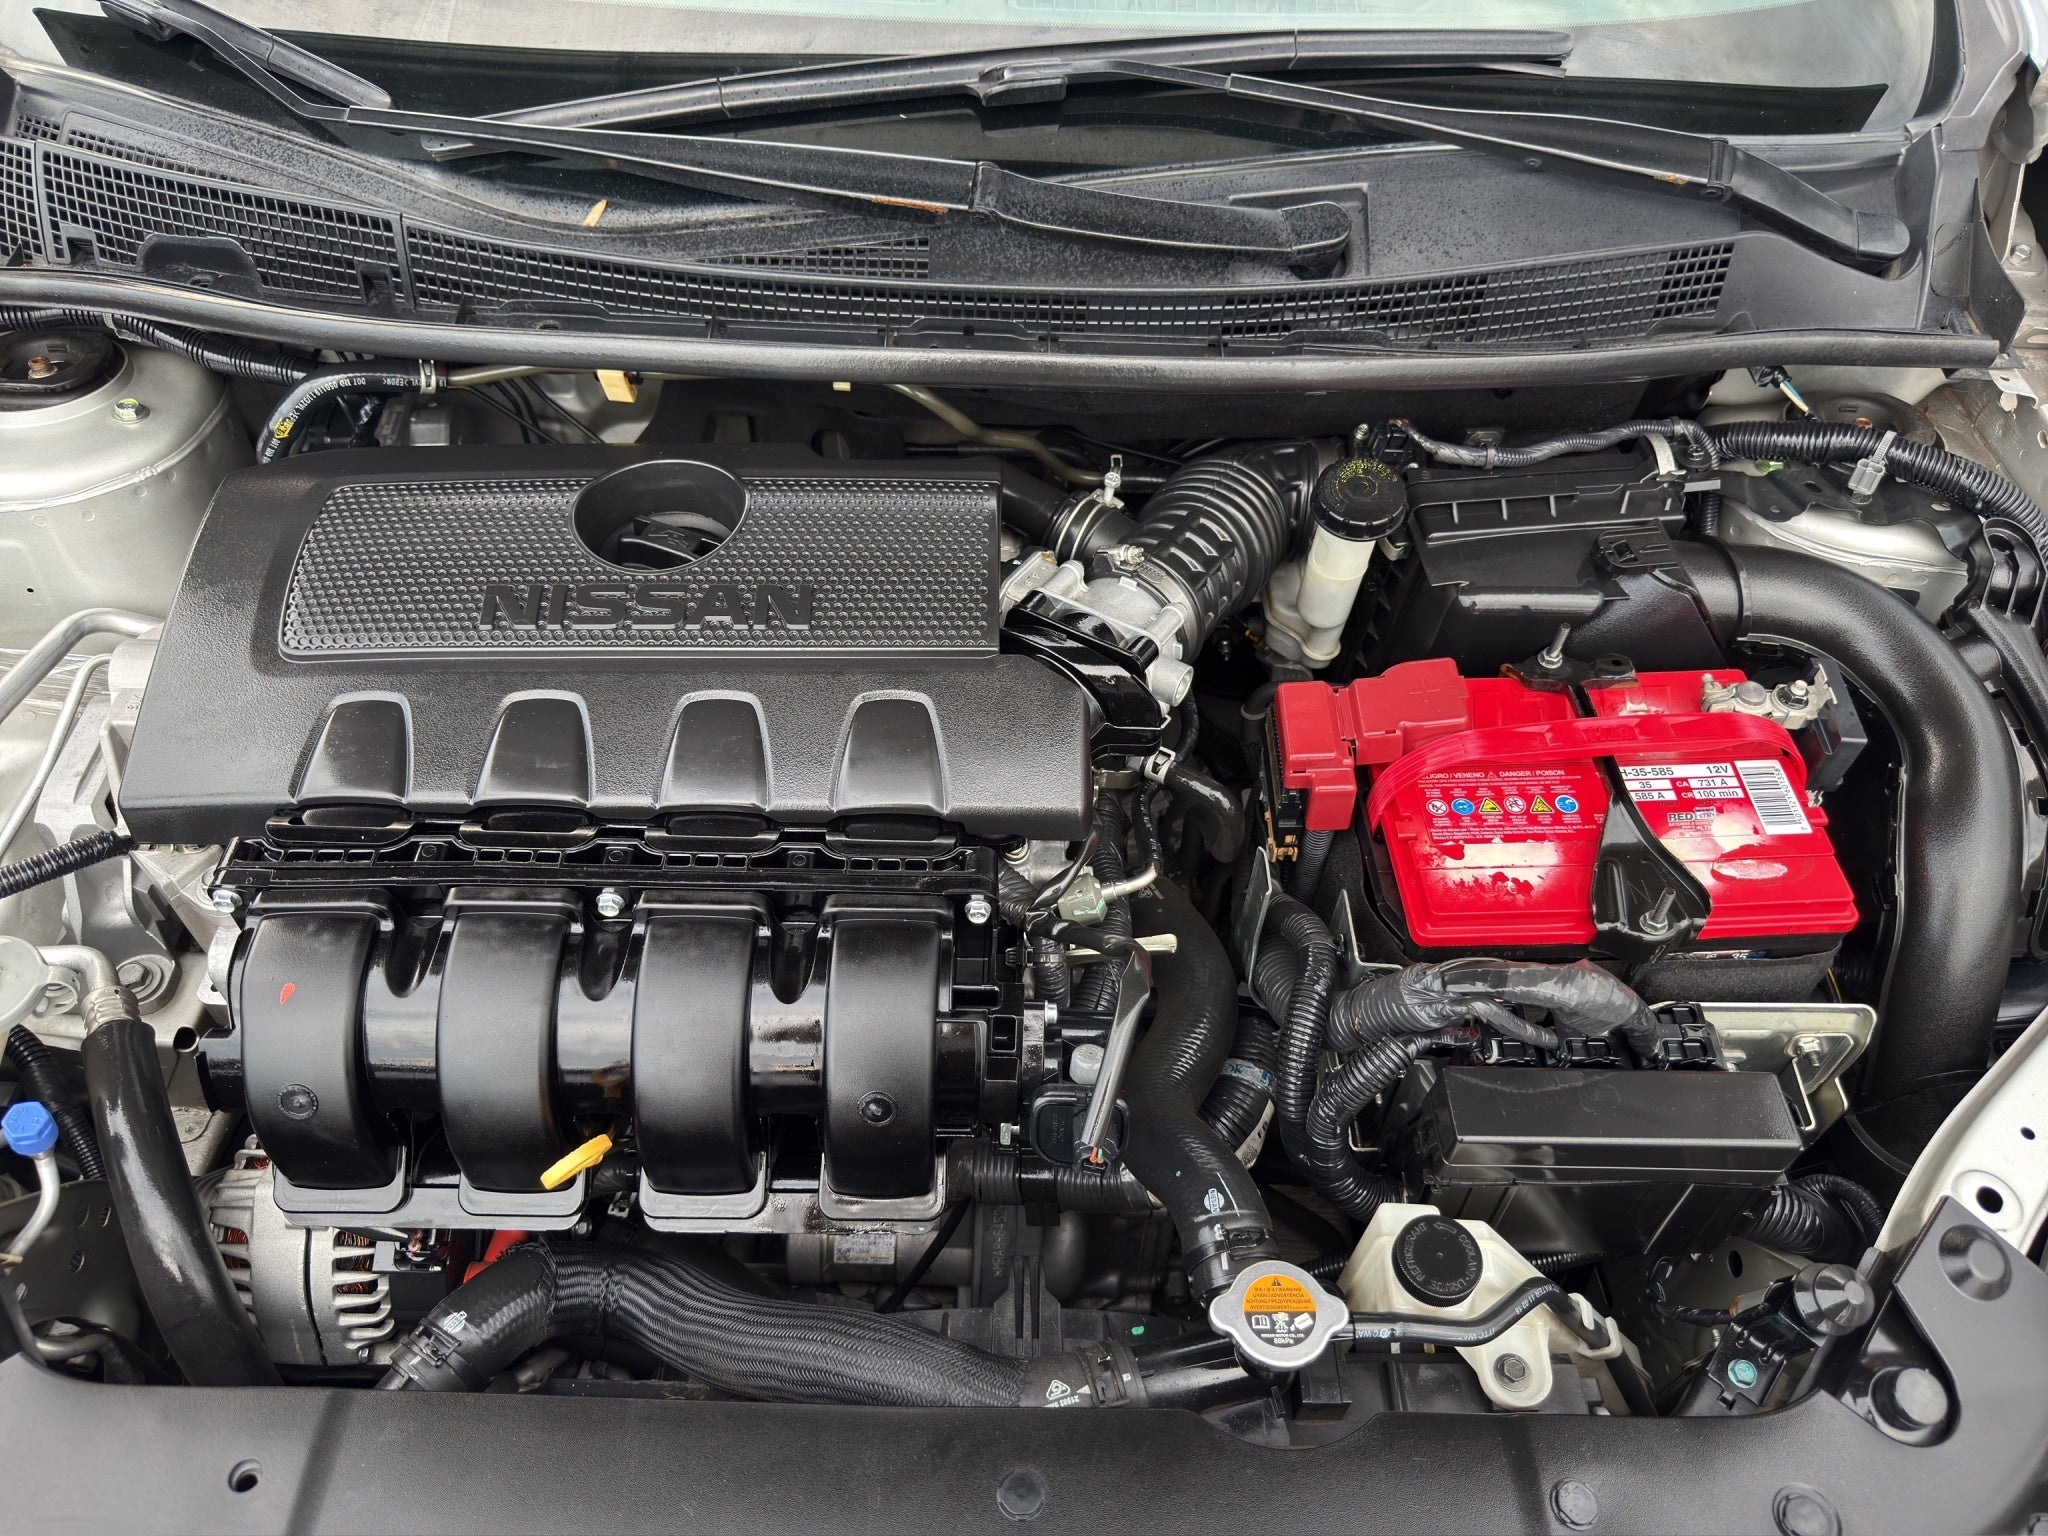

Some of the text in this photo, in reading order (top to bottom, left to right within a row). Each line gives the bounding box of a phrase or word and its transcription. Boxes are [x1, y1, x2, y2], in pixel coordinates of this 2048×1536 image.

[479, 584, 812, 630] NISSAN
[1498, 769, 1531, 778] DANGER
[1705, 765, 1729, 774] 12V
[1453, 771, 1485, 779] VENENO
[1638, 781, 1652, 789] 35
[1675, 778, 1729, 788] CA 731 A
[1634, 791, 1666, 800] 585 A
[1696, 790, 1716, 798] 100
[1718, 789, 1739, 798] min
[1668, 813, 1694, 822] RED
[1209, 1189, 1219, 1213] NISSAN
[1403, 1221, 1427, 1282] REFRIGERANT
[1430, 1233, 1478, 1292] COOLANT LIQUIDE
